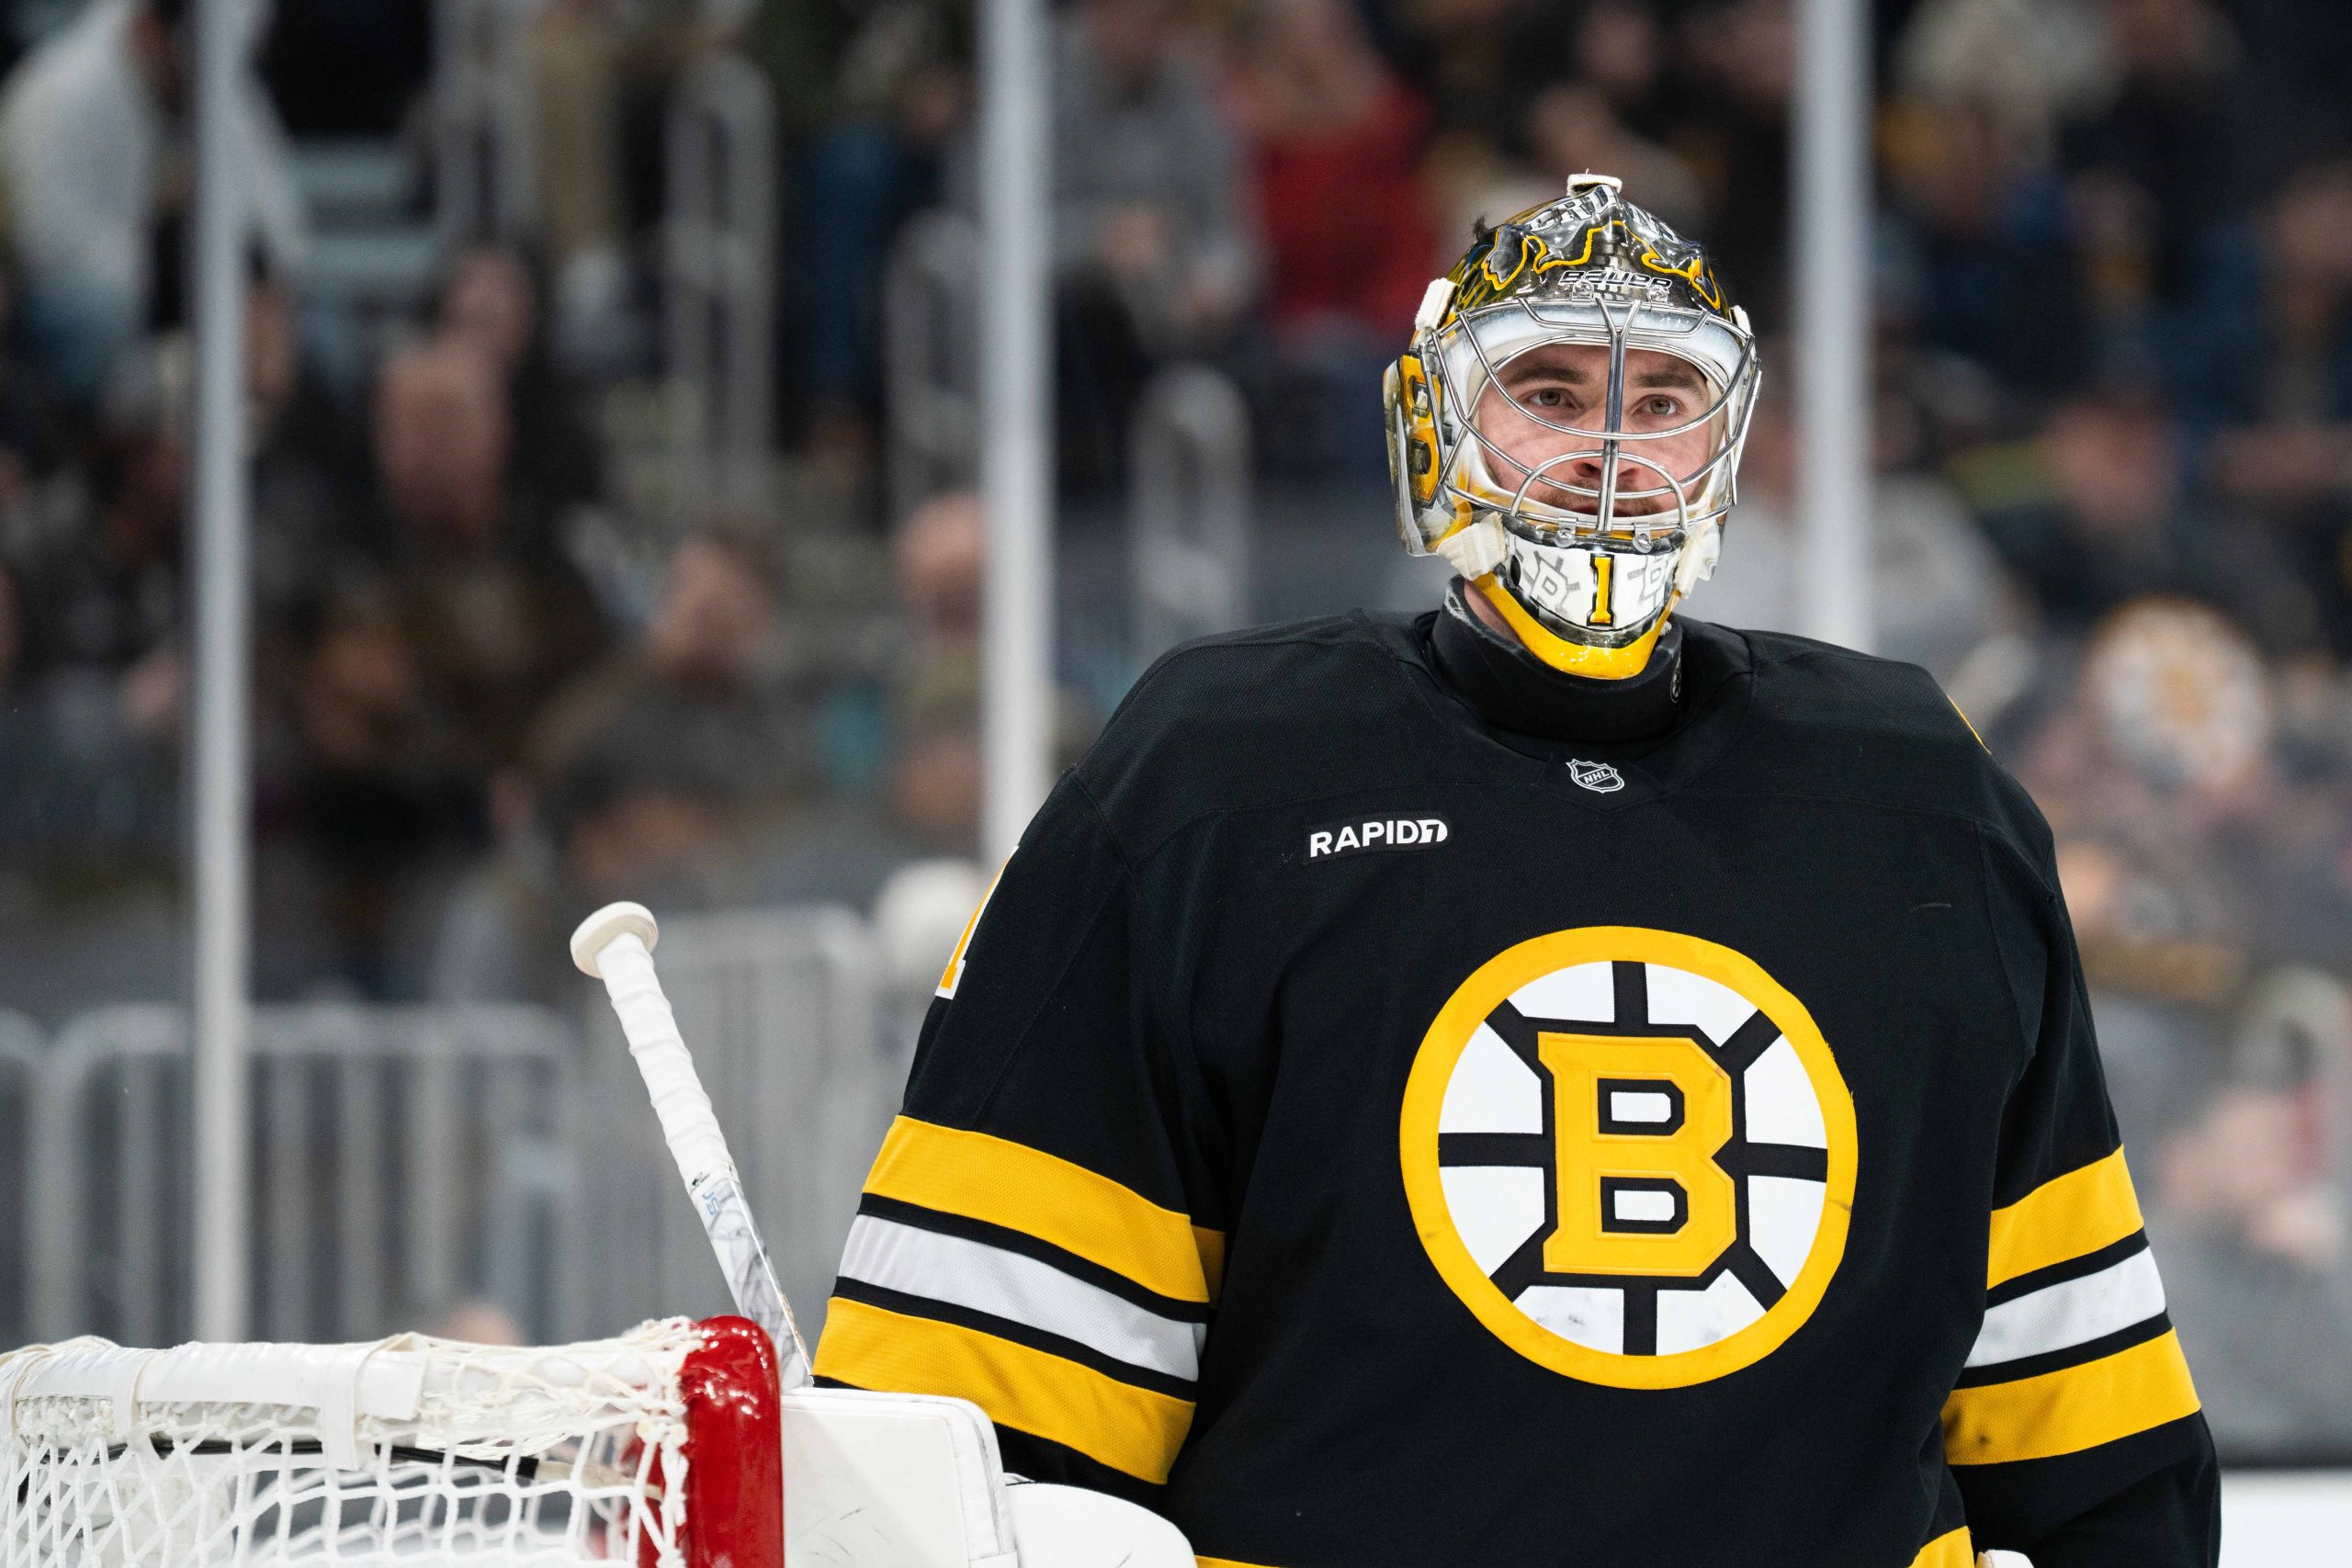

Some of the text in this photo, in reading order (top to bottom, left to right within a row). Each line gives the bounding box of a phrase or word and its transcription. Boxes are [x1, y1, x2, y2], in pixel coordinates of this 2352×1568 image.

[1583, 770, 1611, 784] NHL
[1310, 818, 1449, 858] RAPID7
[1537, 1031, 1737, 1278] B
